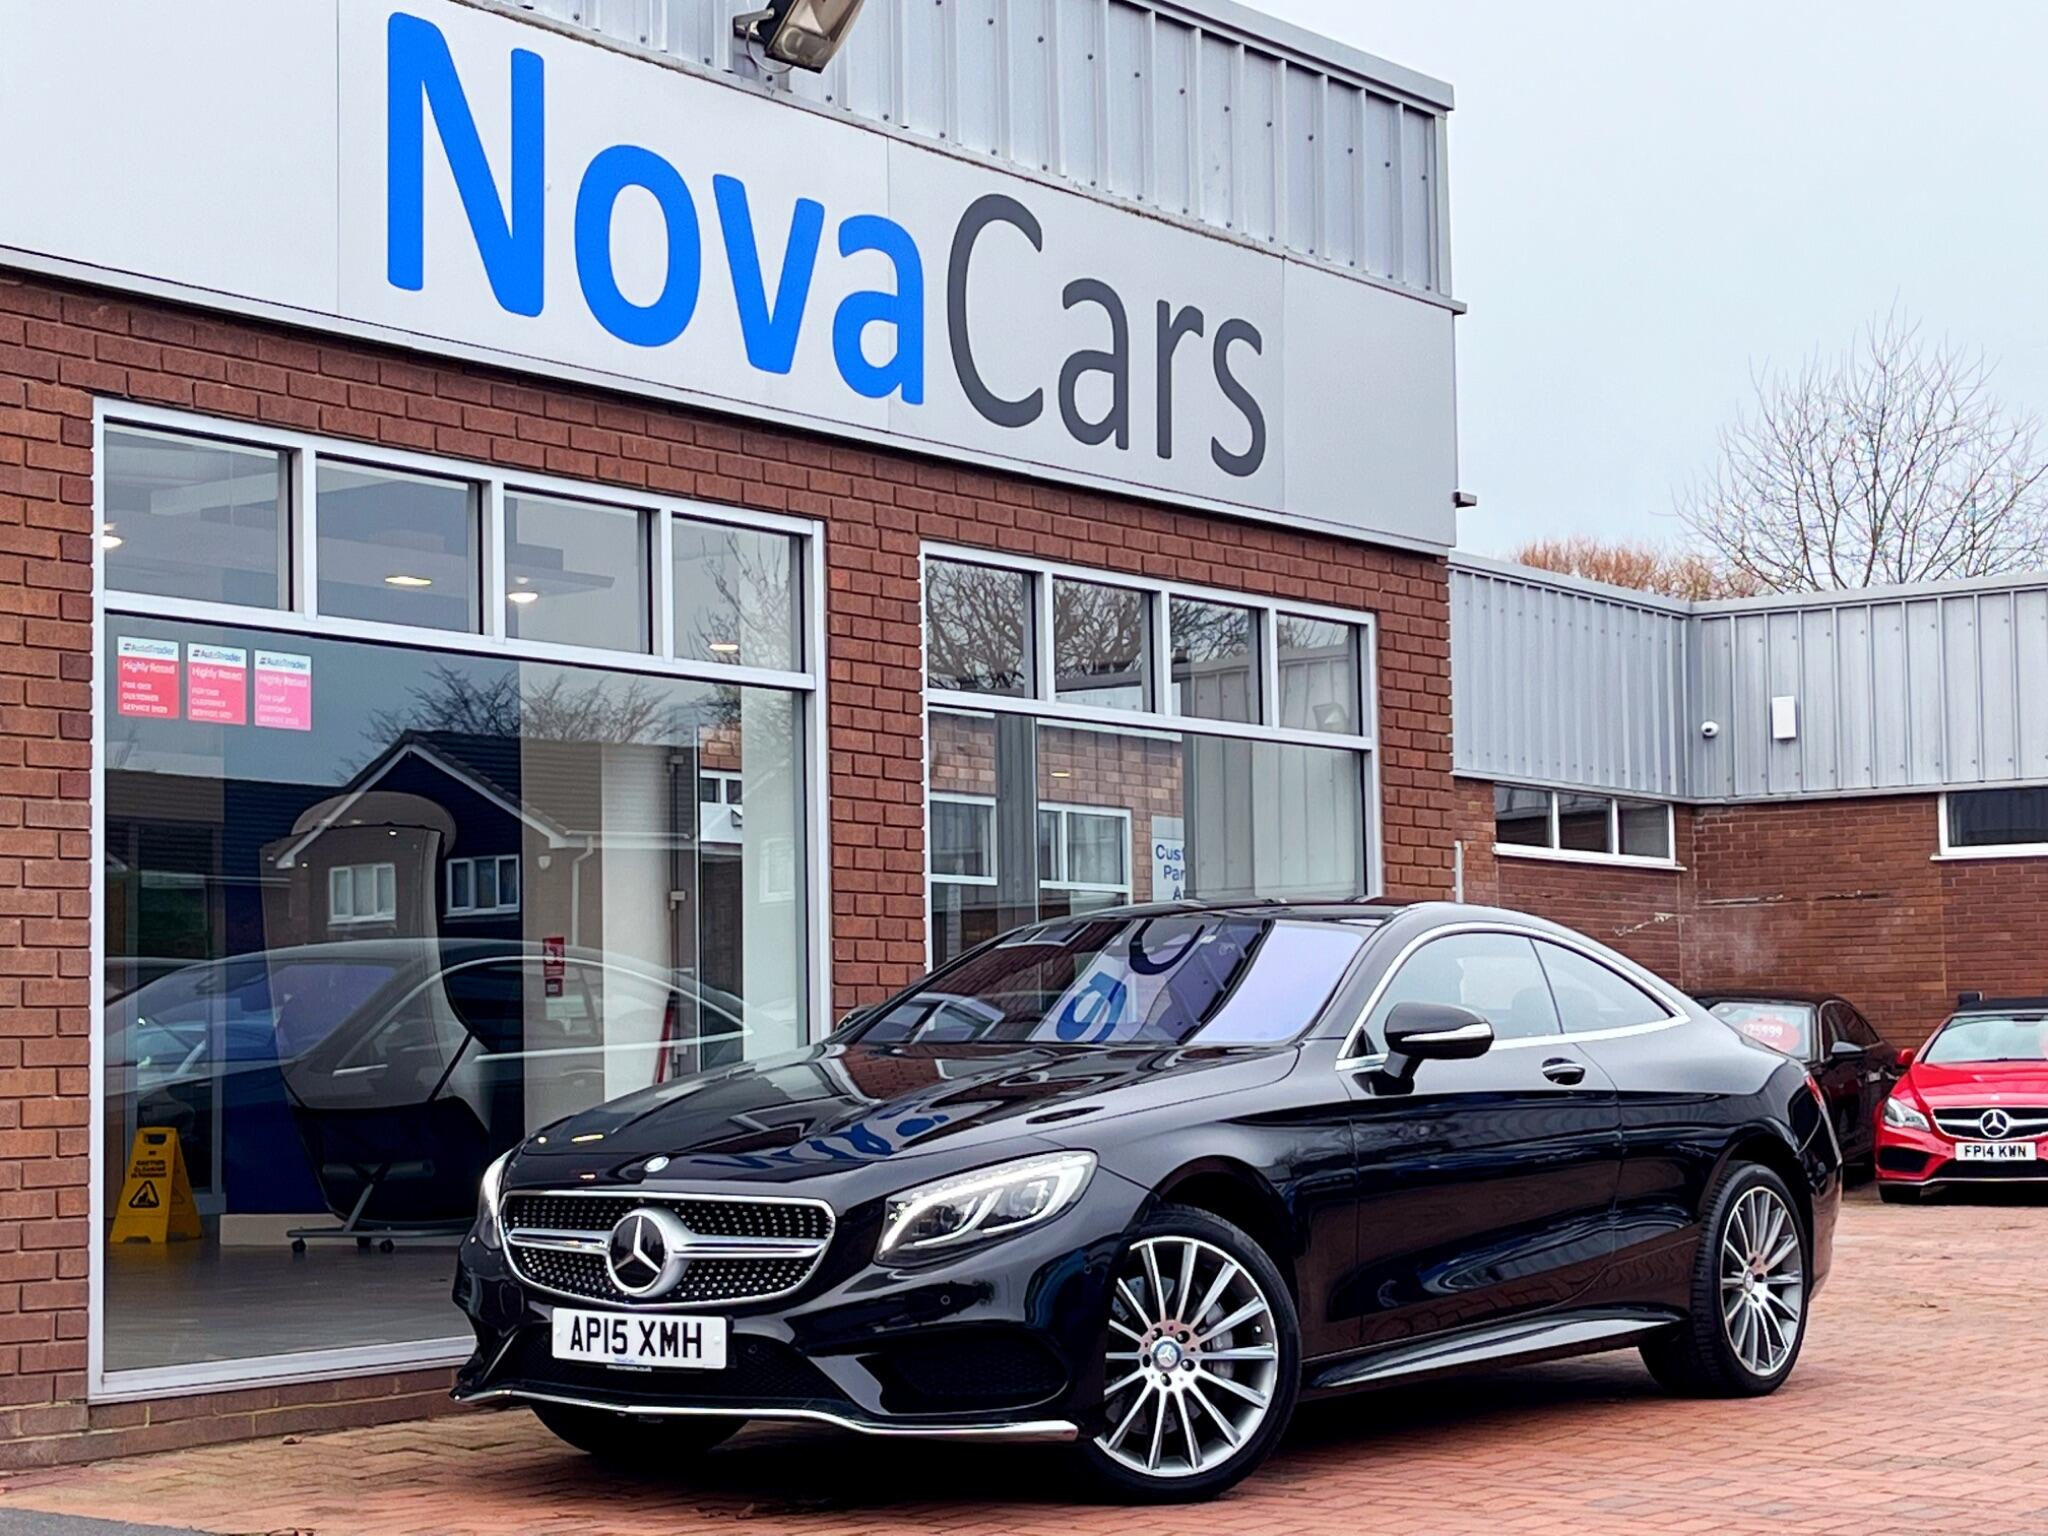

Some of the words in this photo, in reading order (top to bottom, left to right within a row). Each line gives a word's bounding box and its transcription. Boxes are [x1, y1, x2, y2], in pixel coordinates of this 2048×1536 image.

[1964, 1145, 1994, 1158] FP14
[1998, 1145, 2027, 1158] KWN
[570, 1315, 628, 1355] AP15
[638, 1320, 702, 1359] XMH
